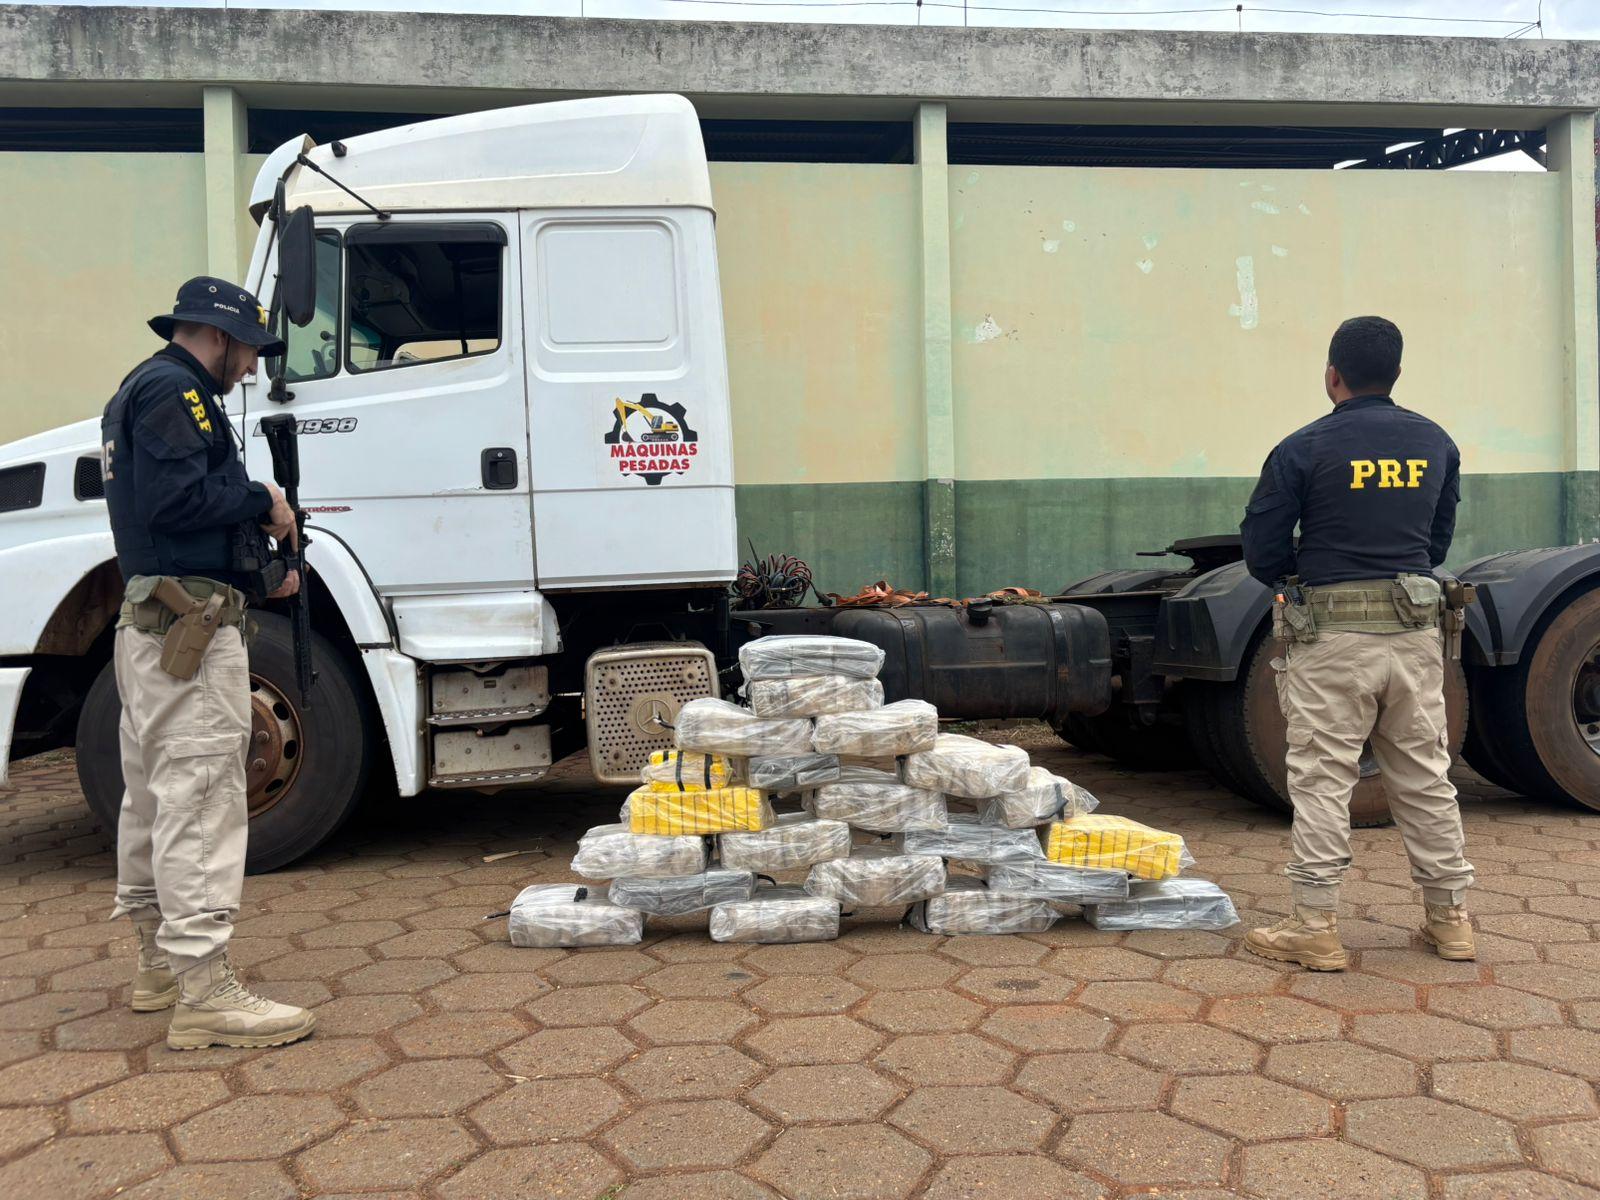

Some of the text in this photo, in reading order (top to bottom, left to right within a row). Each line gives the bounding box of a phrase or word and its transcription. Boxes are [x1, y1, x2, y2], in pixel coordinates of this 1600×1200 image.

[183, 388, 213, 433] PRF
[296, 417, 358, 435] 1938
[619, 458, 690, 471] PESADAS
[1350, 459, 1428, 489] PRF
